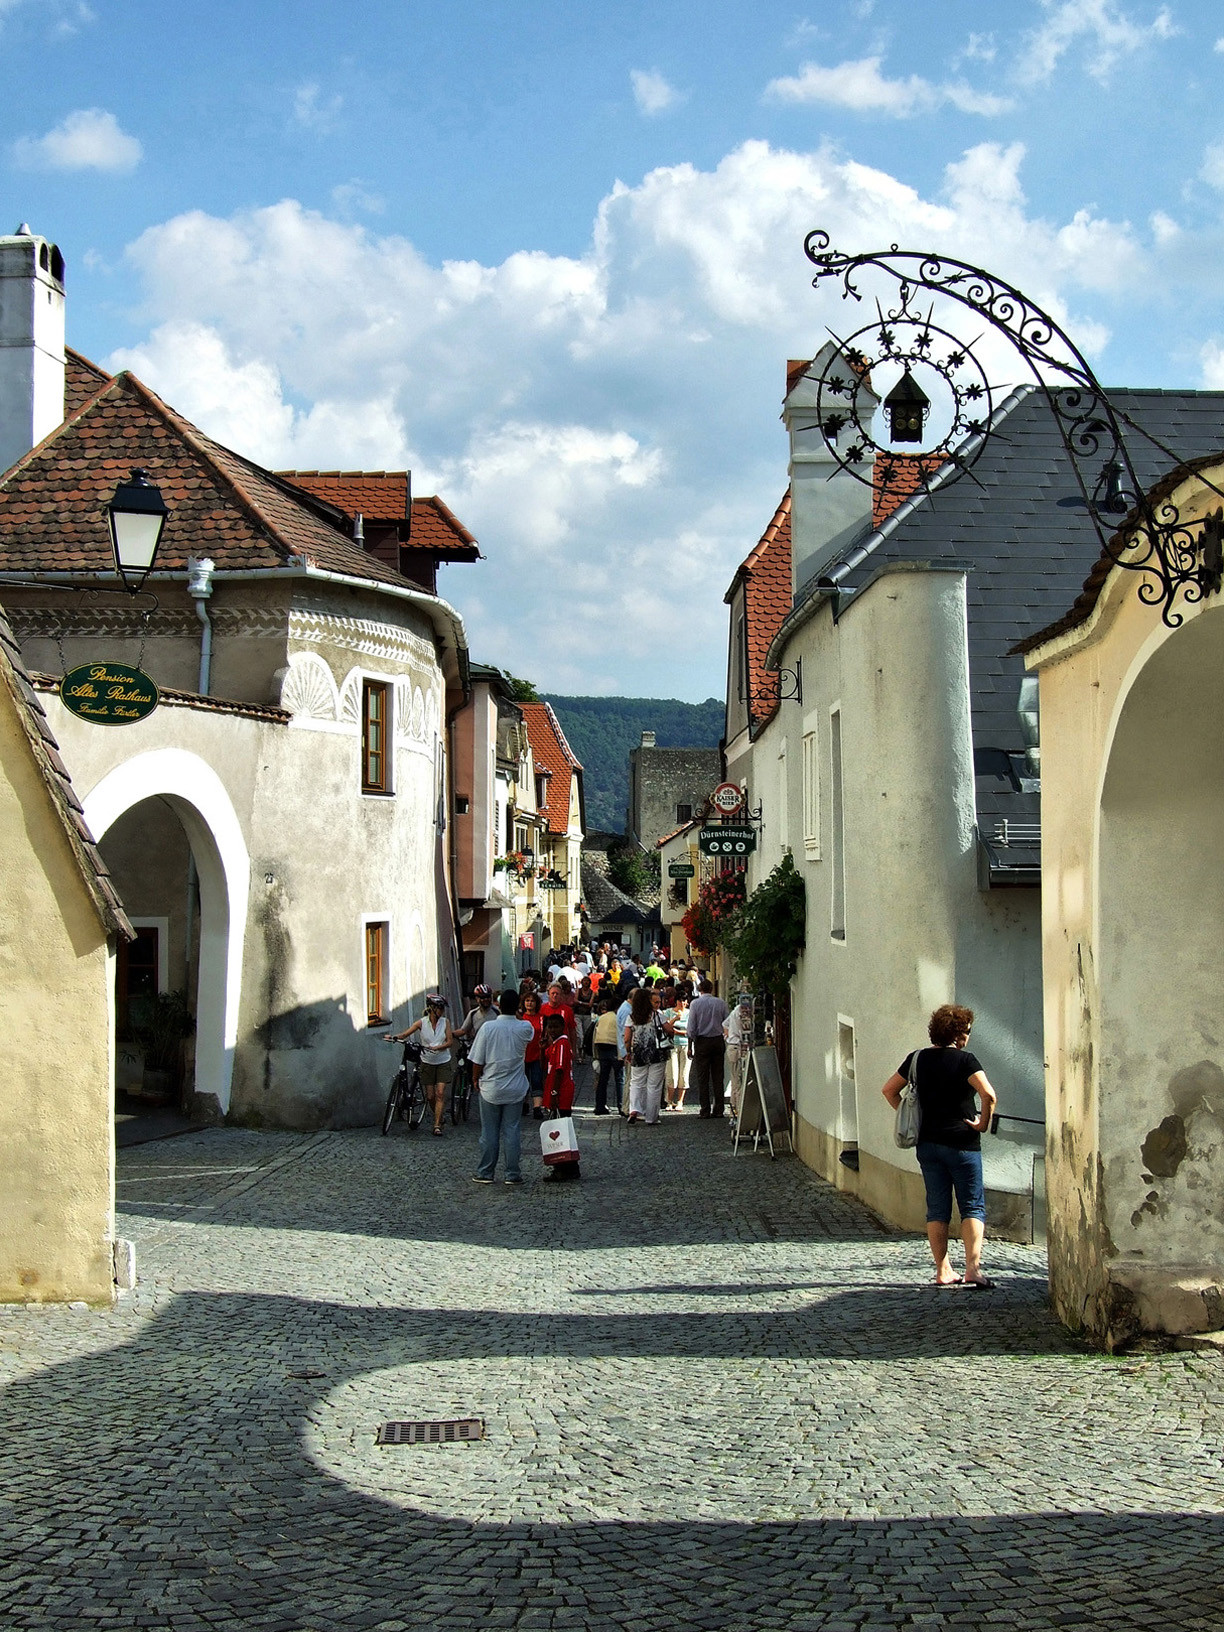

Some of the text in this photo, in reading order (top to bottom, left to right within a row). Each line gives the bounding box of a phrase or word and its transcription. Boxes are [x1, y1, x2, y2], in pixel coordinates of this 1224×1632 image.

[87, 666, 135, 684] Pension
[65, 683, 152, 703] Altes Rathaus
[77, 702, 109, 715] Familie
[716, 795, 740, 803] KAISER
[700, 829, 755, 840] Dürnsteinerhof
